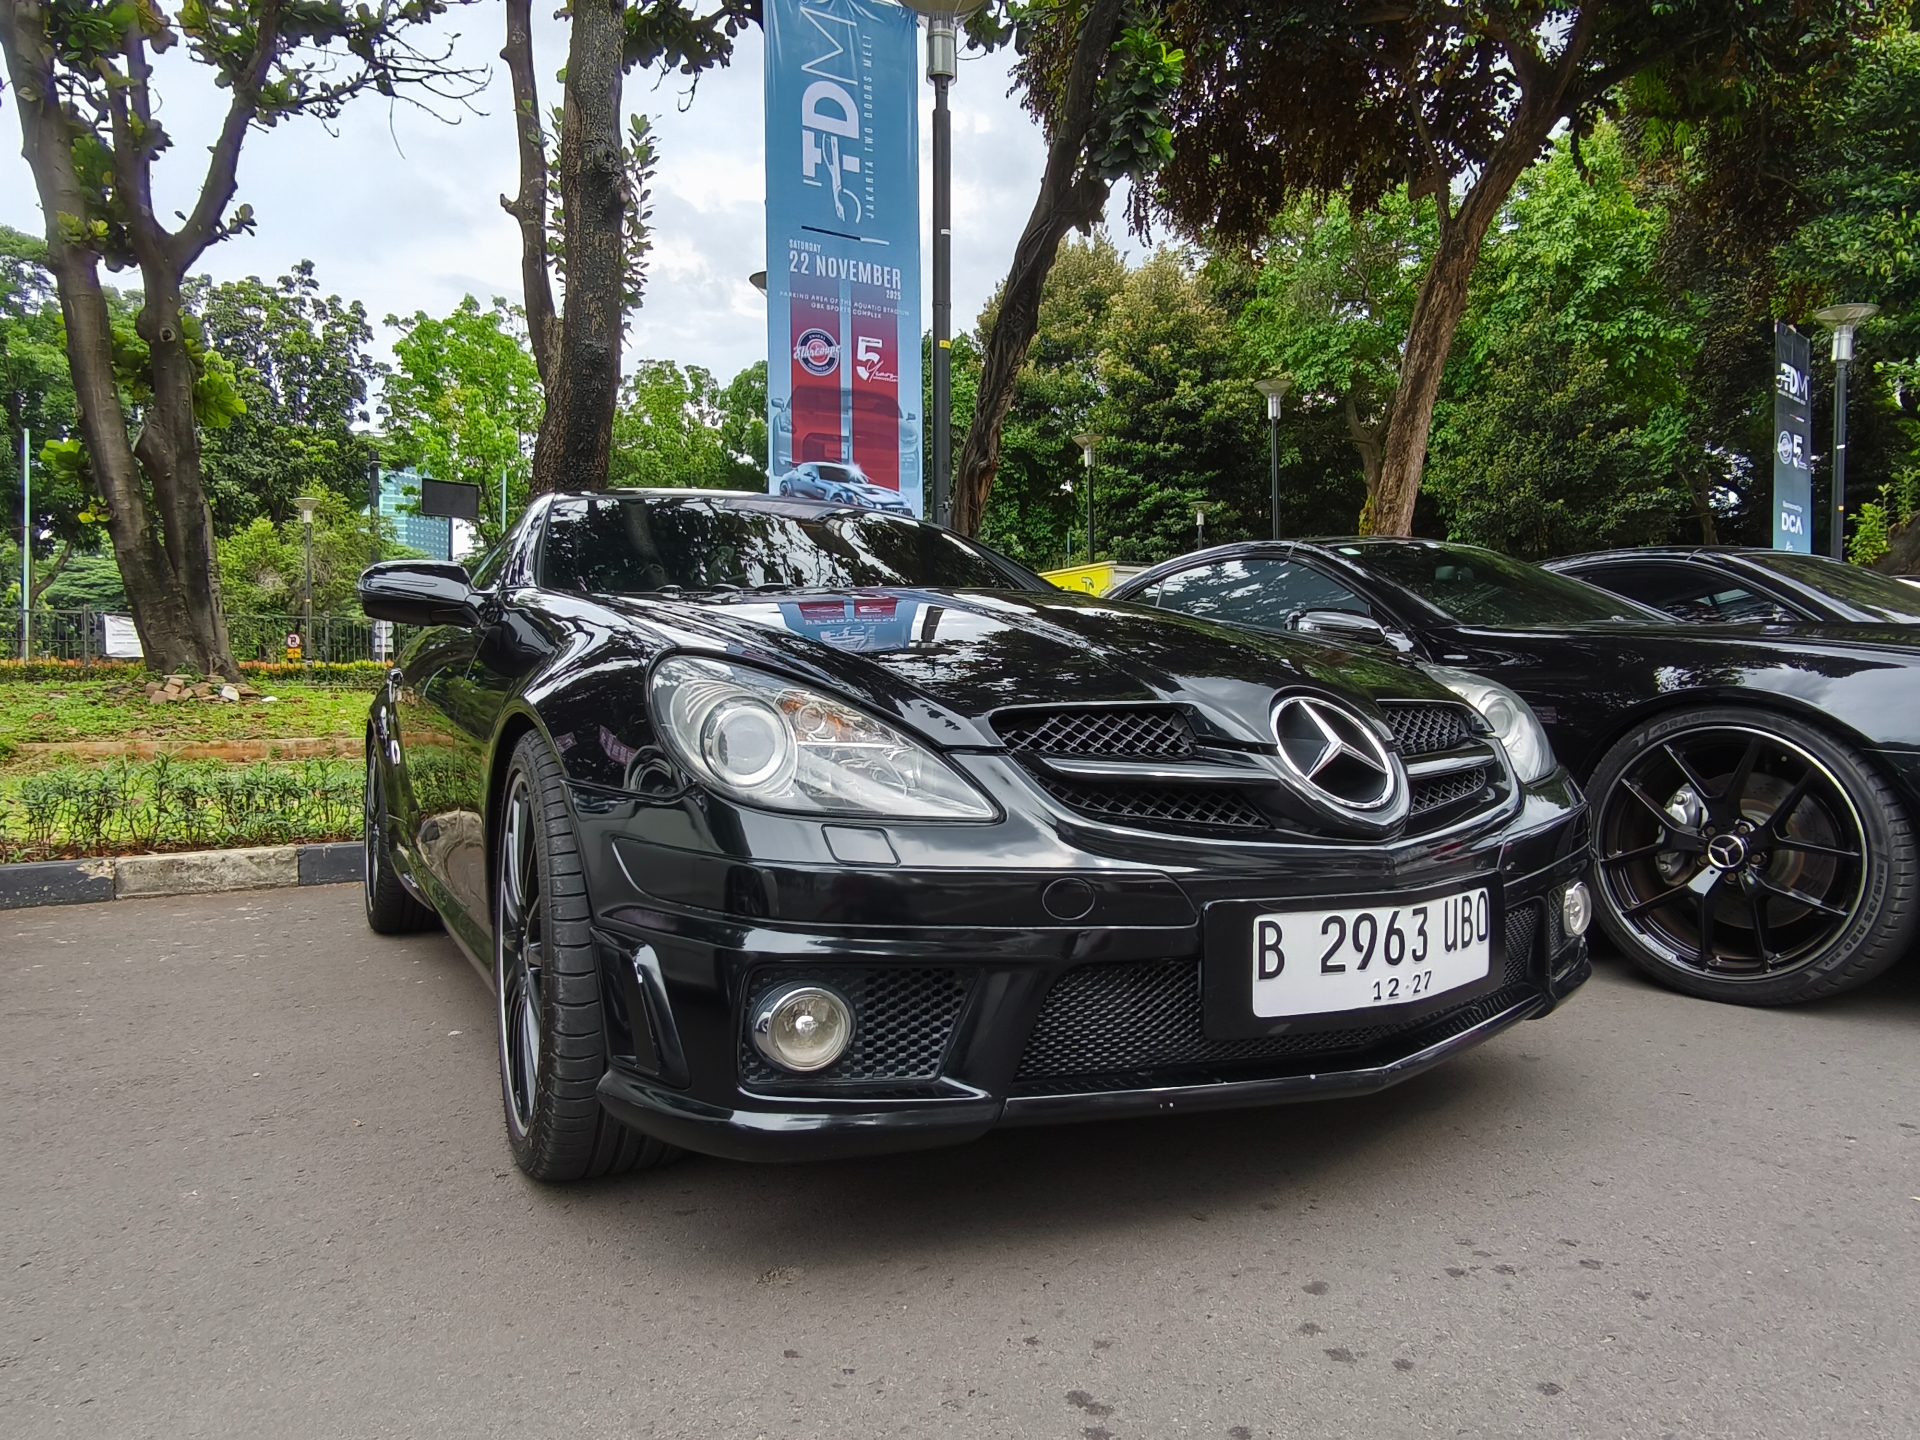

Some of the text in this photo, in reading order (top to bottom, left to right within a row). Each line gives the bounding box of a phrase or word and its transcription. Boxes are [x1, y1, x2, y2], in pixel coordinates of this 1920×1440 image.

[862, 34, 875, 219] JAKARTA TWO DOORS MEET
[789, 239, 821, 254] SATURDAY
[789, 250, 901, 290] 22 NOVEMBER
[780, 290, 809, 300] PARKING
[811, 294, 828, 303] AREA
[840, 298, 851, 307] THE
[886, 290, 901, 300] 2025
[826, 303, 851, 314] SPORTS
[852, 309, 882, 319] COMPLEX
[856, 336, 883, 381] 5
[1258, 890, 1489, 980] B 2963 UBO
